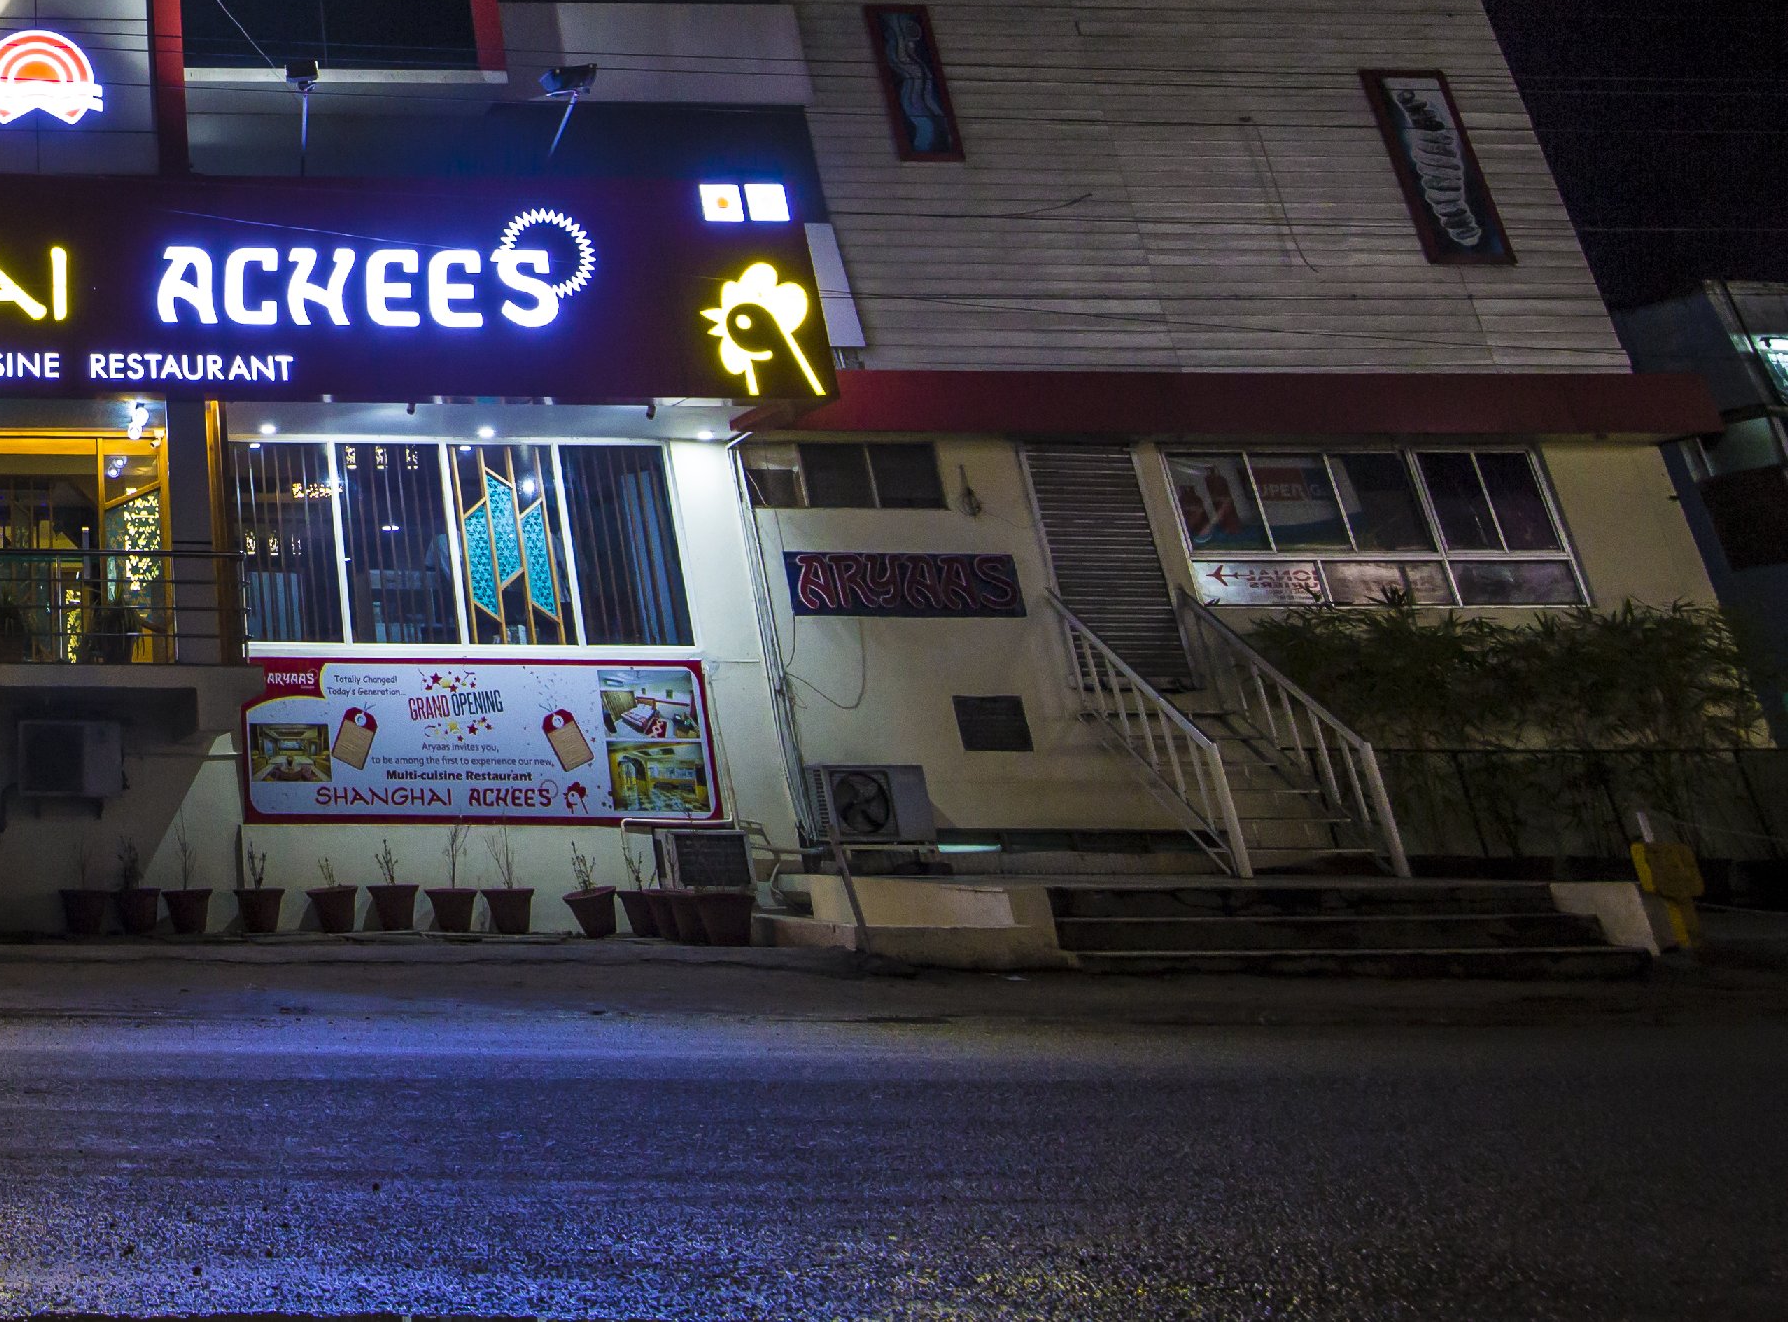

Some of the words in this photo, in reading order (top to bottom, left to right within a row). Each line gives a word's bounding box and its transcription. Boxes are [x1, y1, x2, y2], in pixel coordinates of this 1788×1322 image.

[155, 245, 562, 328] ACKEES
[89, 352, 295, 382] RESTAURANT
[795, 553, 1020, 610] ARYAAS
[266, 672, 316, 686] ARYAAS
[333, 674, 361, 686] Totally
[362, 674, 398, 686] Changed!
[326, 686, 356, 698] Today's
[408, 694, 450, 721] GRAND
[451, 689, 504, 717] OPENING
[421, 741, 451, 753] Aryaas
[452, 741, 480, 752] invites
[371, 756, 380, 765] to
[382, 756, 393, 765] be
[395, 757, 424, 767] among
[426, 756, 440, 766] the
[441, 756, 458, 766] first
[459, 757, 469, 766] to
[470, 757, 517, 768] experience
[518, 758, 533, 767] our
[386, 769, 463, 781] Multi-cuisine
[465, 770, 533, 782] Restaurant
[314, 785, 452, 807] SHANGHAI
[468, 787, 553, 808] ACKEES
